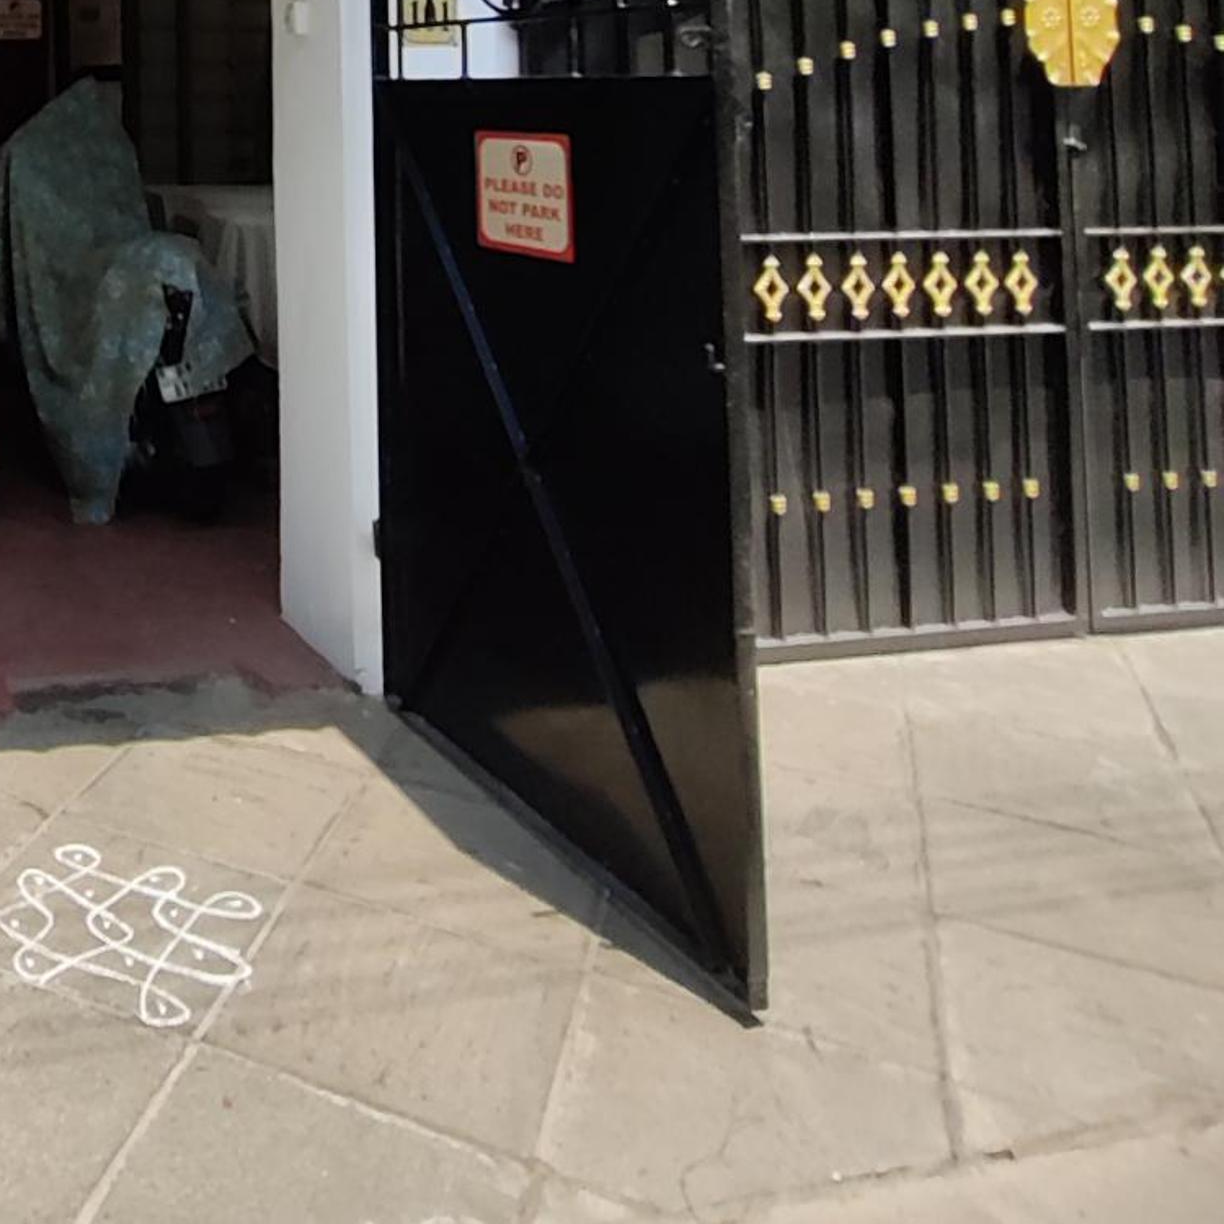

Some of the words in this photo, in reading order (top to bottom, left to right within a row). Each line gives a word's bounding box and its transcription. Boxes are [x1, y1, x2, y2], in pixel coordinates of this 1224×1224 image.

[485, 177, 537, 196] PLEASE
[542, 183, 564, 199] DO
[488, 199, 517, 215] NOT
[522, 203, 561, 221] PARK
[505, 222, 544, 241] HERE
